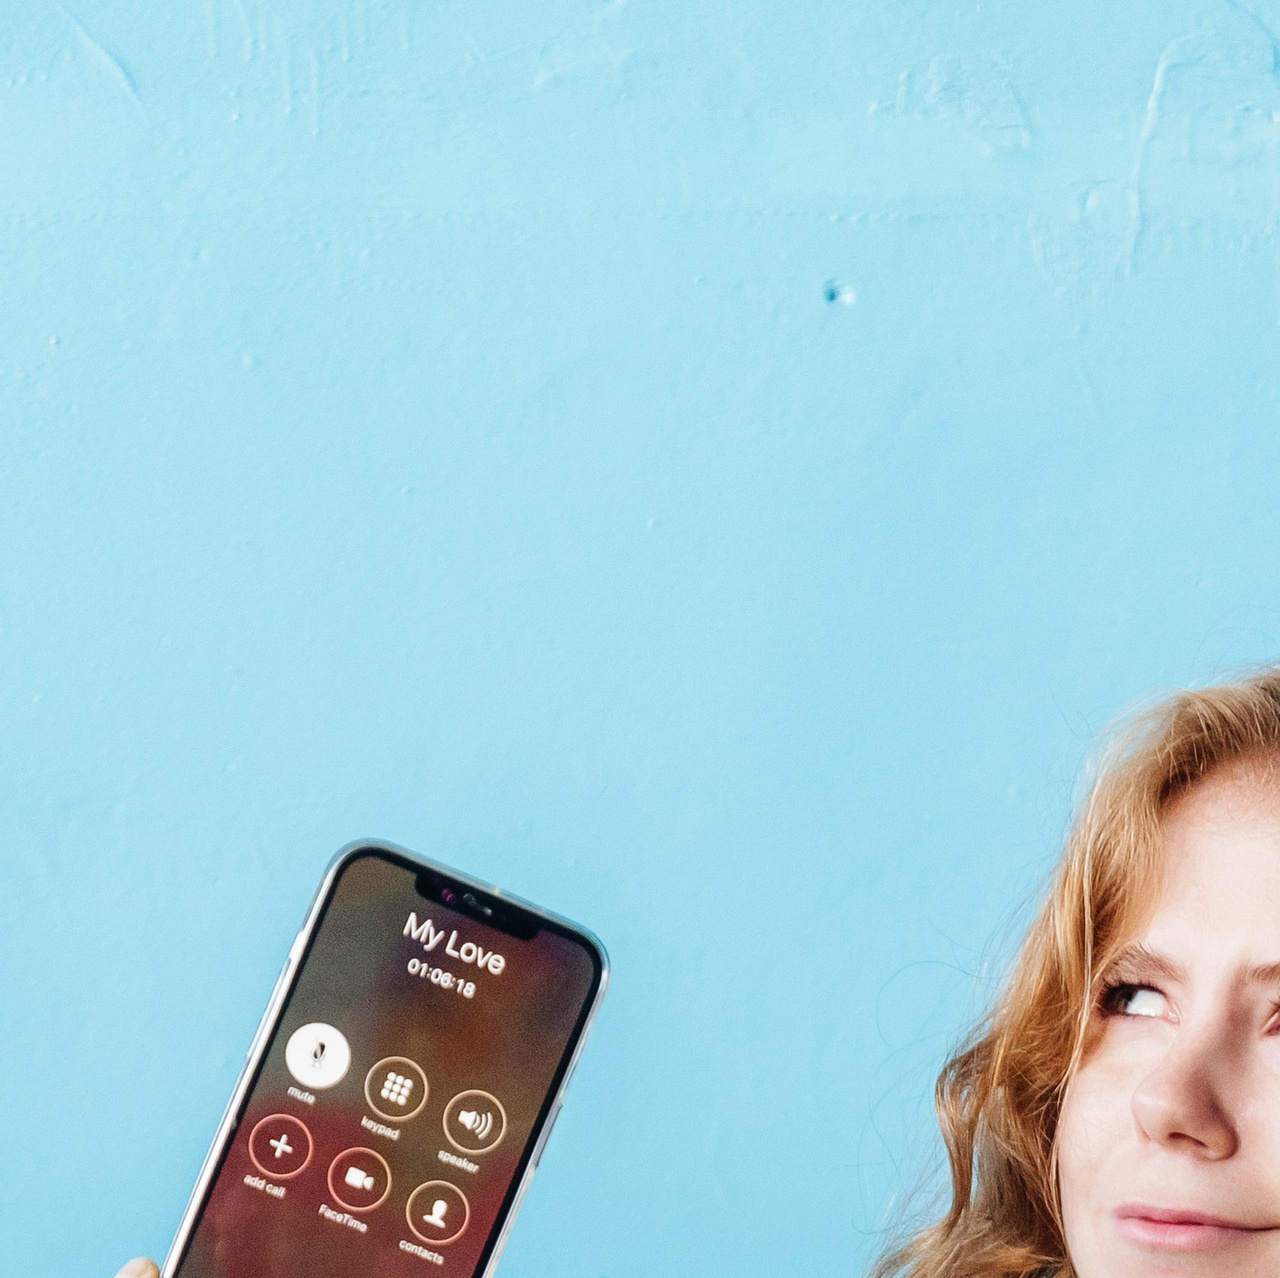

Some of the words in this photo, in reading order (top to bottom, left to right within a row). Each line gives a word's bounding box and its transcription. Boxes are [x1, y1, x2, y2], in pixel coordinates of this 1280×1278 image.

[403, 912, 445, 951] My
[445, 930, 506, 975] Love
[407, 958, 476, 999] 01:06:18
[287, 1086, 316, 1106] mute
[360, 1115, 400, 1141] keypad
[437, 1150, 480, 1175] speaker
[243, 1173, 267, 1191] add
[265, 1183, 286, 1199] call
[318, 1203, 368, 1233] FaceTime
[399, 1239, 445, 1266] contacts
